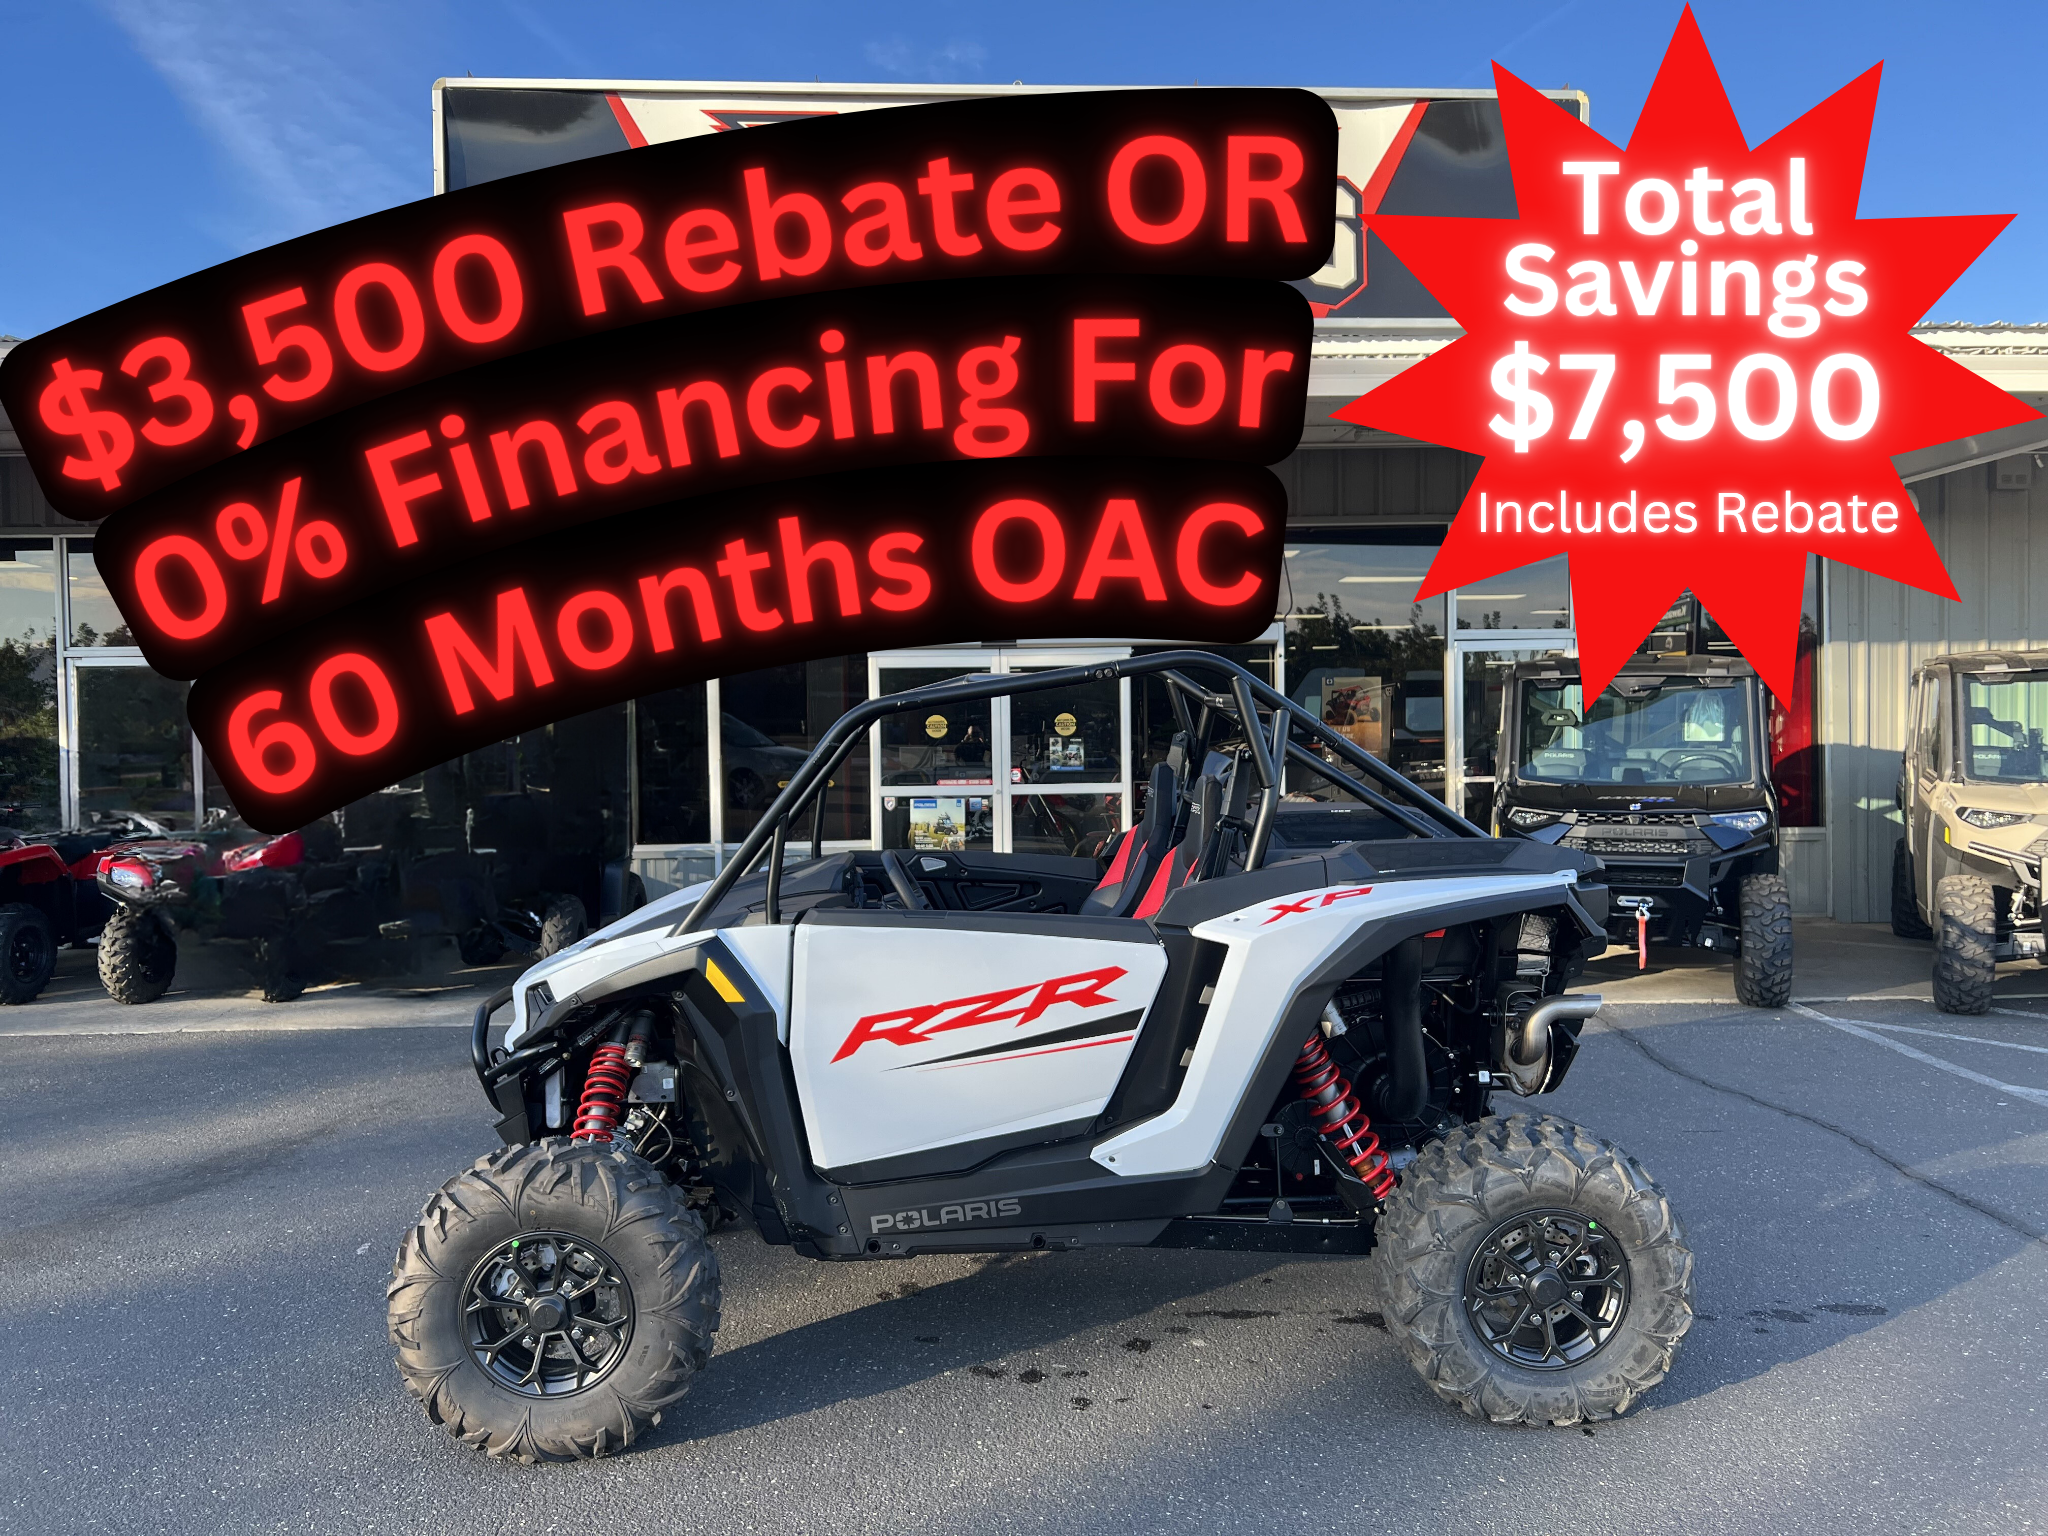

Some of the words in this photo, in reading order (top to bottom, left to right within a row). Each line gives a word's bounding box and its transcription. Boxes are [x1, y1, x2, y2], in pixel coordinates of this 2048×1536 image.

[1601, 827, 1669, 838] POLARIS
[1258, 886, 1374, 928] XP
[830, 965, 1129, 1065] RZR
[869, 1198, 1022, 1234] POLARIS
